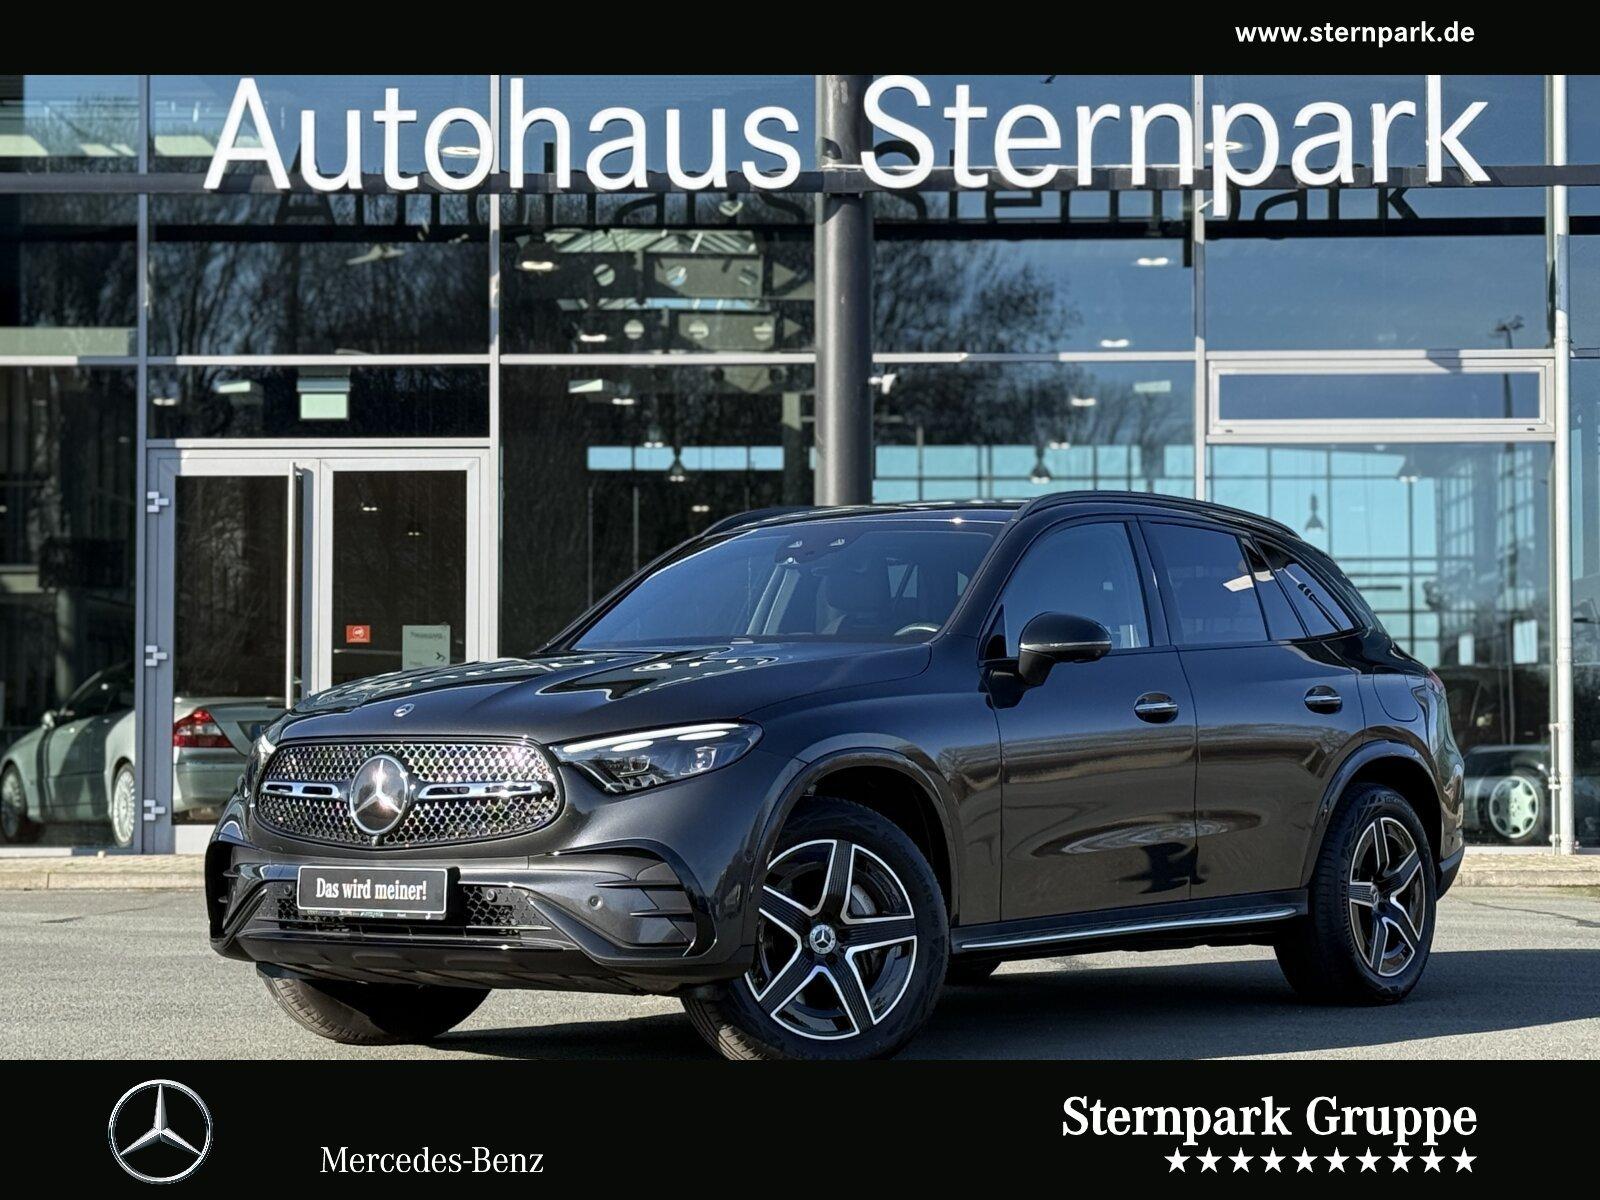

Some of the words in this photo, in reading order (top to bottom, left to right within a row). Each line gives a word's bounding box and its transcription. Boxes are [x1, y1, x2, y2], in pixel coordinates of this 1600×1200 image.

[203, 77, 801, 192] Autohaus
[860, 75, 1491, 216] Sternpark
[315, 877, 340, 899] Das
[341, 878, 372, 899] wird
[374, 879, 428, 901] meiner!
